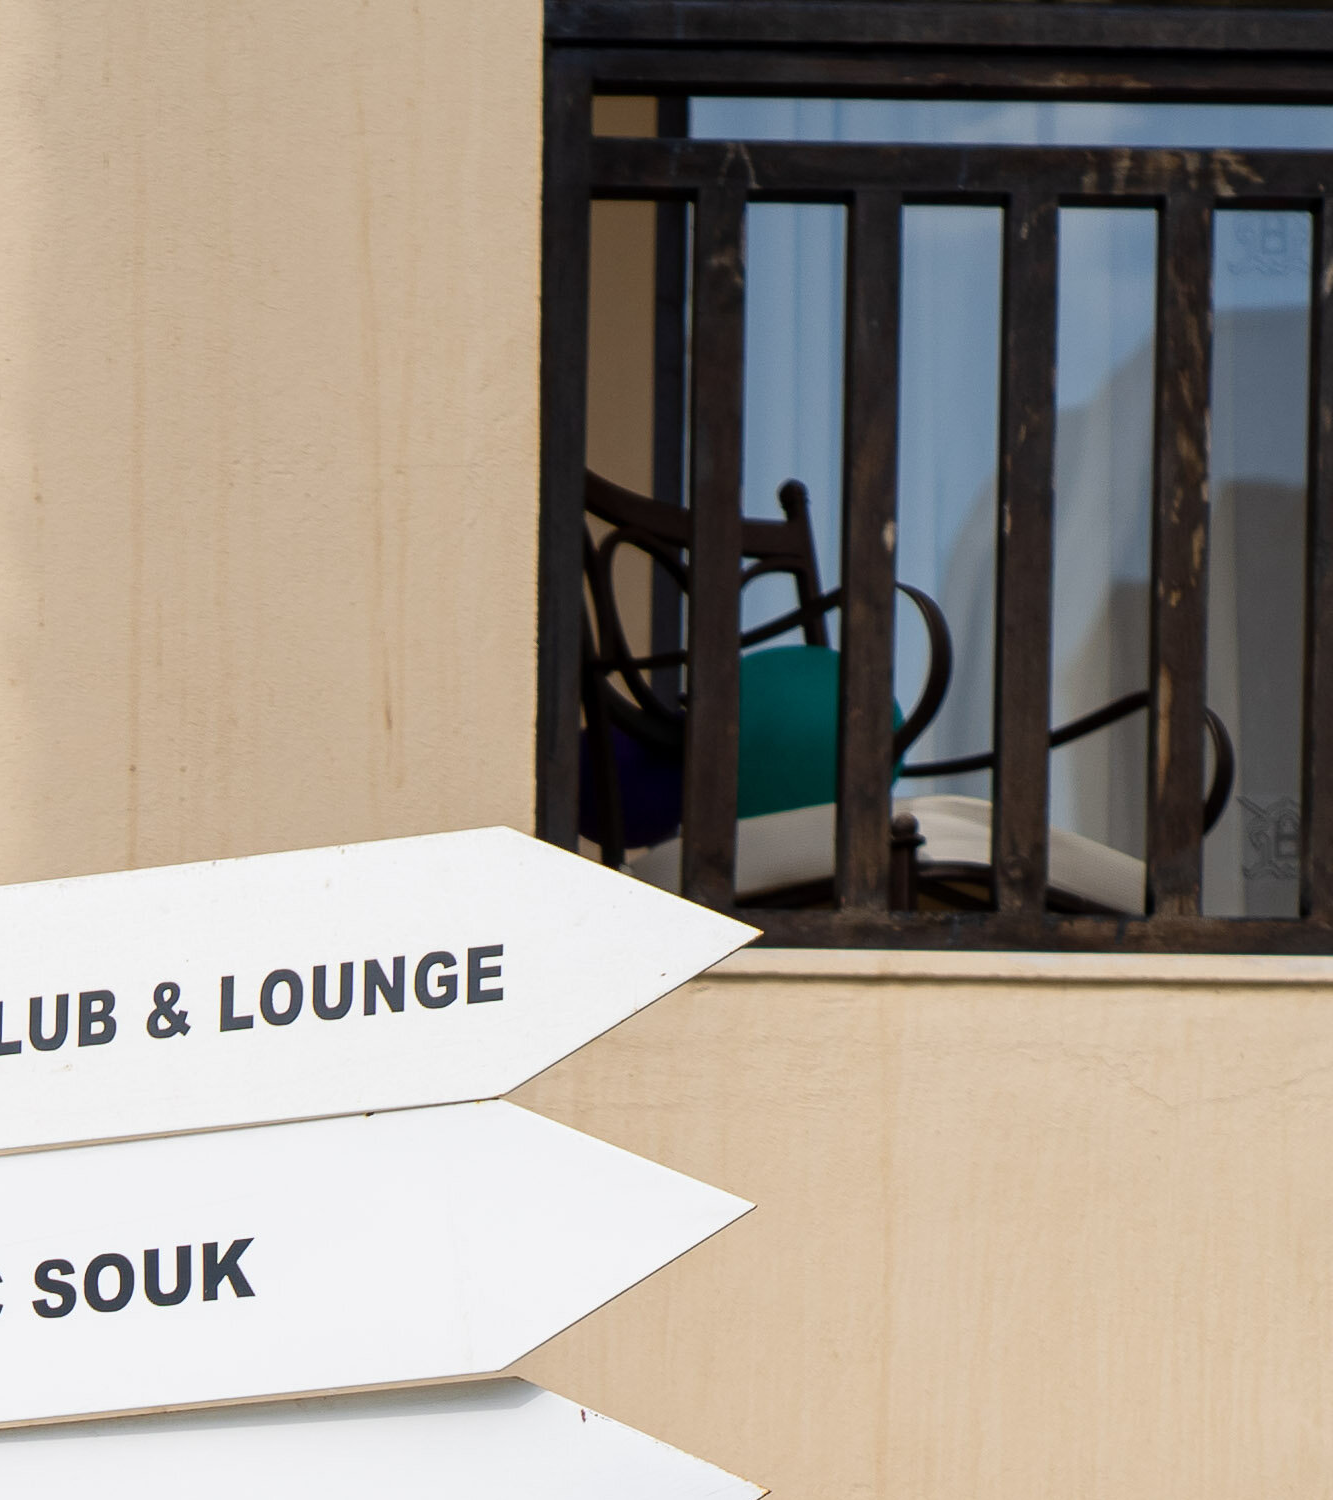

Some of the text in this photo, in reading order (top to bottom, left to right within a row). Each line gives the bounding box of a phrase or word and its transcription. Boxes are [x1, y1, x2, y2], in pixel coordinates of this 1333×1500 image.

[146, 981, 191, 1039] &
[219, 943, 504, 1033] LOUNGE
[31, 1237, 256, 1319] SOUK
